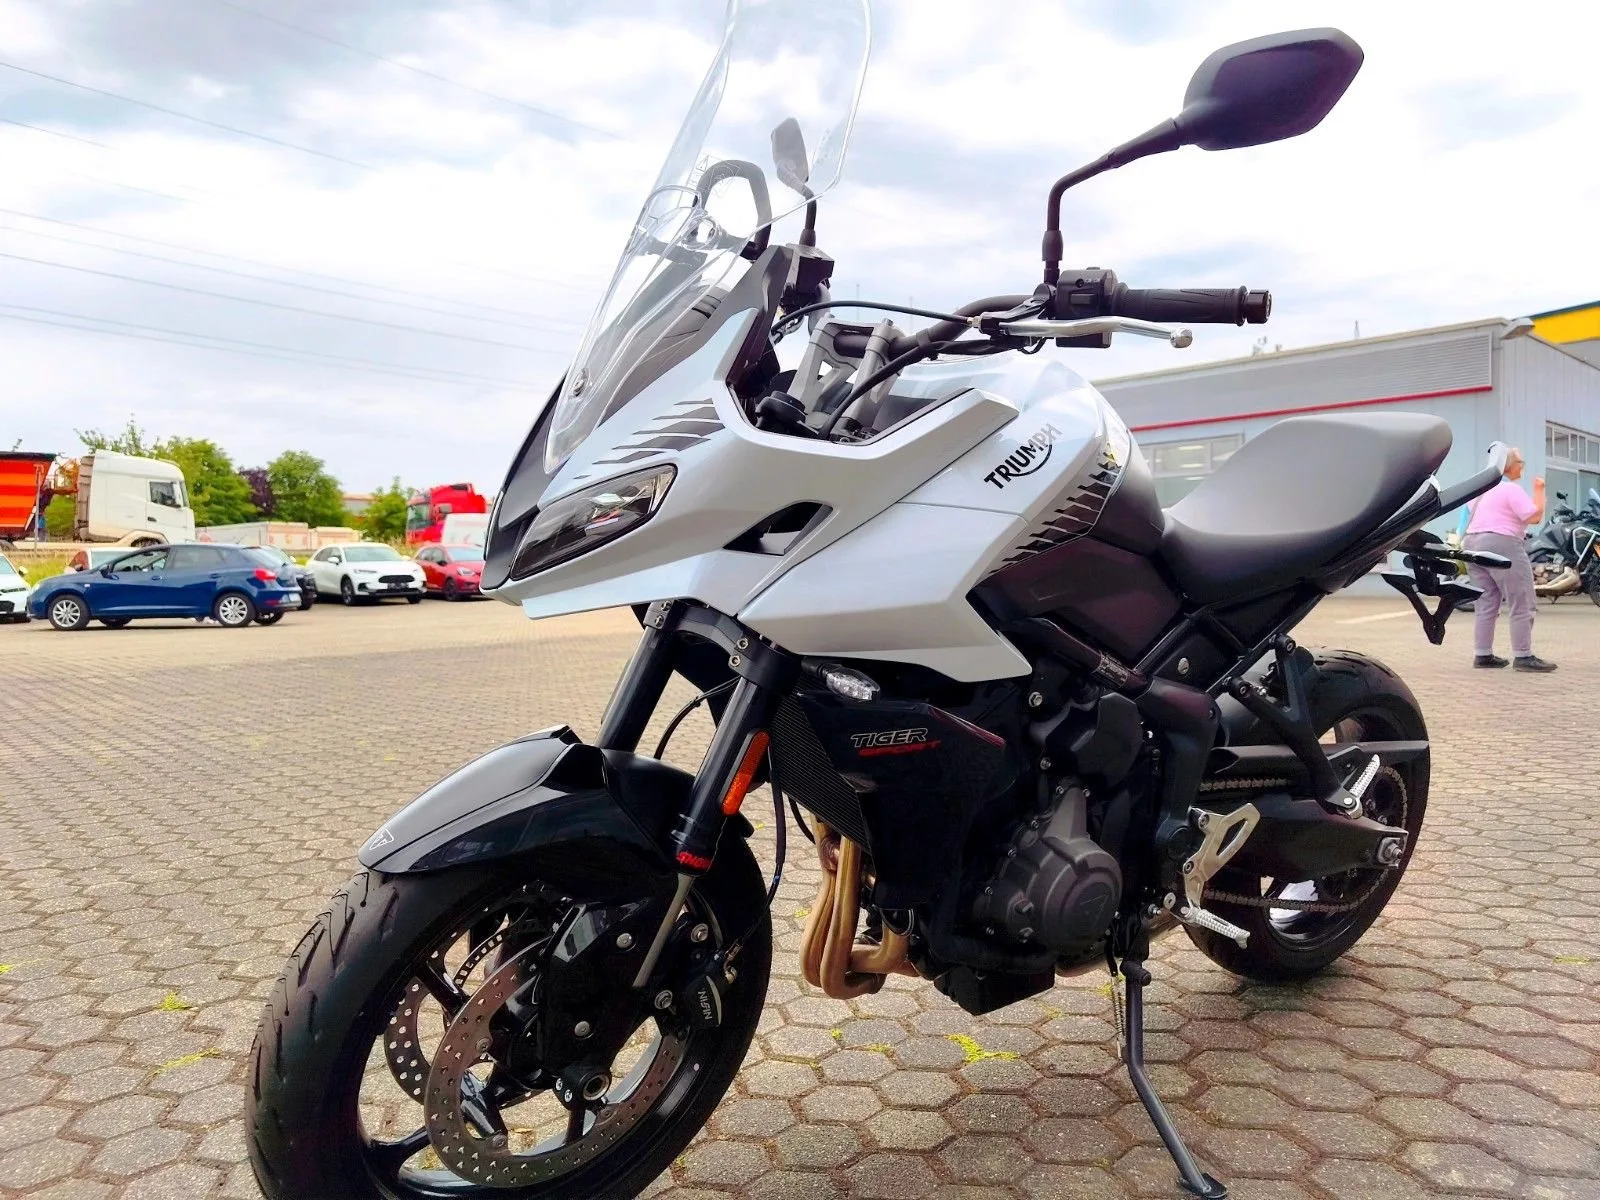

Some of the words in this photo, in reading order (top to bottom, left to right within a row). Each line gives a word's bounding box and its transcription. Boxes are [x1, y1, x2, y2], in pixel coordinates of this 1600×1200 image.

[984, 423, 1063, 489] TRIUMPH
[850, 728, 928, 748] TIGER
[697, 991, 713, 1020] NISSIN
